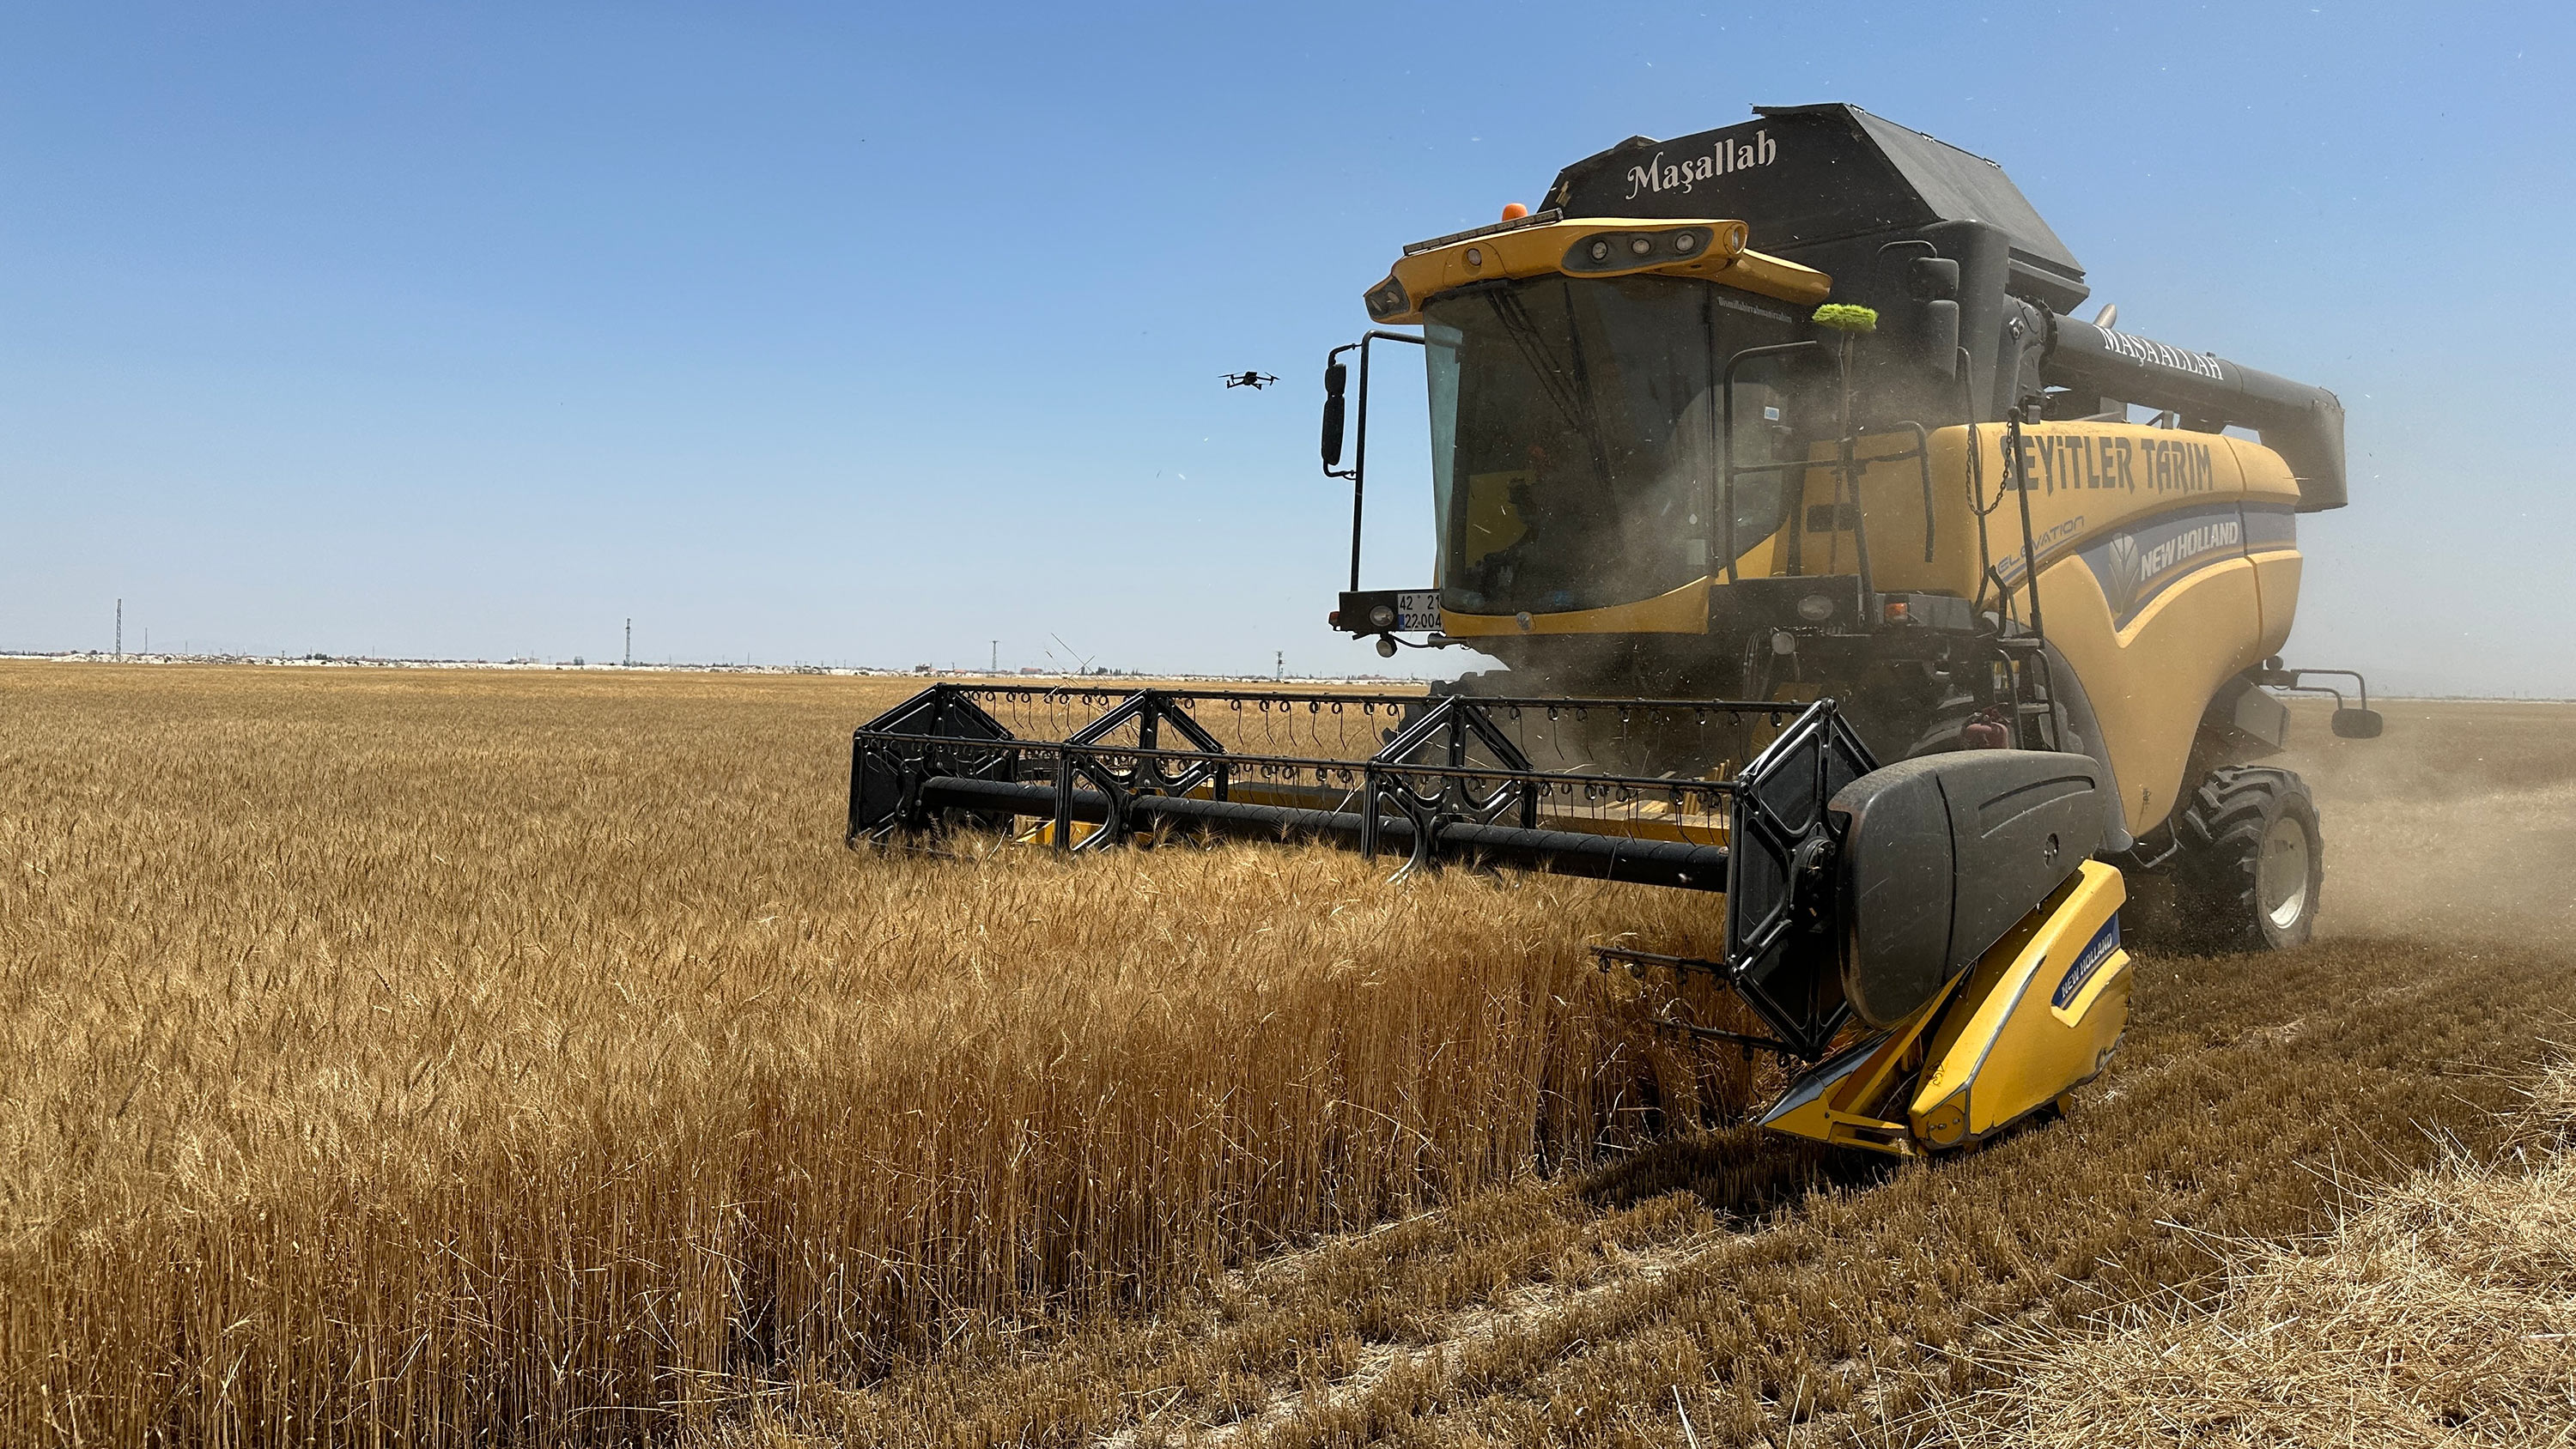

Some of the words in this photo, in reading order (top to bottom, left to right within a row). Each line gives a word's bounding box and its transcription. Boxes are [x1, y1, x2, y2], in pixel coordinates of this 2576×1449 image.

[1625, 130, 1777, 200] Maşallah
[2093, 324, 2224, 380] MAŞAALLAH
[2141, 438, 2214, 494] TARIM
[2141, 538, 2177, 582] NEW
[2177, 521, 2239, 561] HOLLAND
[1400, 596, 1413, 610] 42
[2061, 967, 2080, 998] NEW
[2079, 932, 2112, 976] HOLLAND
